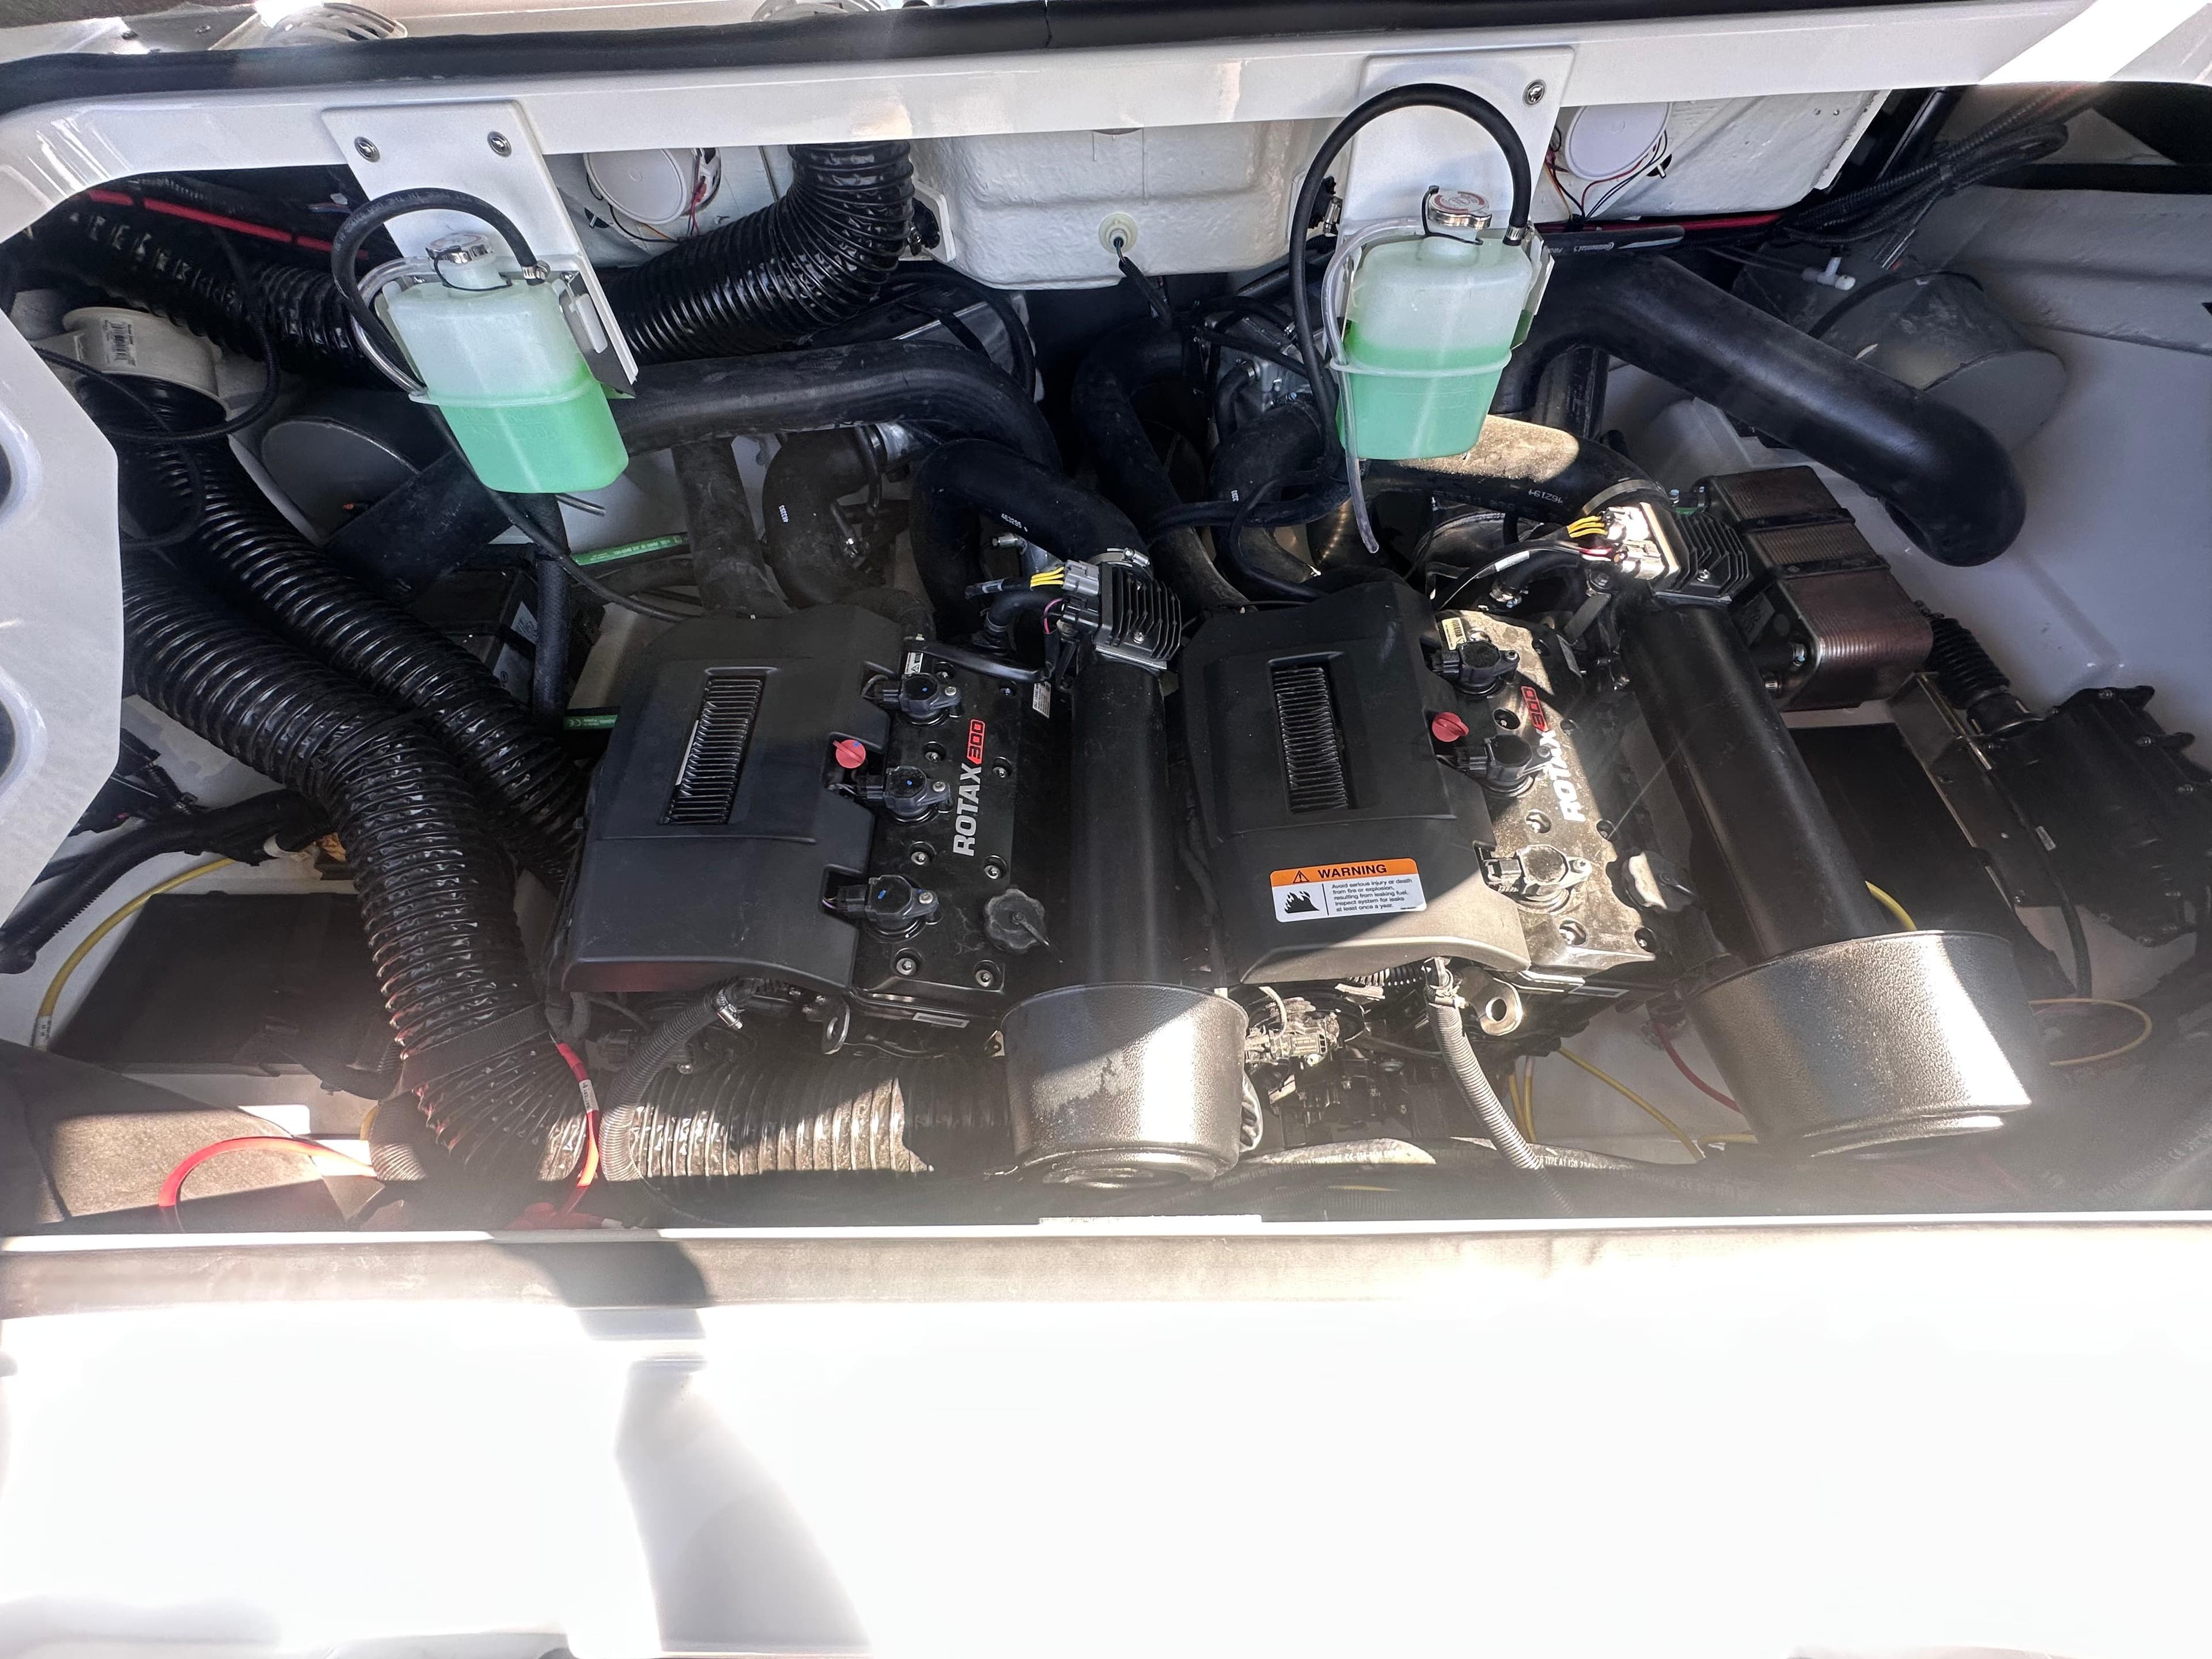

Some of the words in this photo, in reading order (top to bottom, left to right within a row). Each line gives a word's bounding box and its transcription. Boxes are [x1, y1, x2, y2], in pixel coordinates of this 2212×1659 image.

[1522, 687, 1546, 728] 300
[953, 763, 982, 857] ROTAX
[968, 720, 984, 759] 300
[1318, 864, 1387, 878] WARNING
[1544, 1156, 1558, 1166] TYPE
